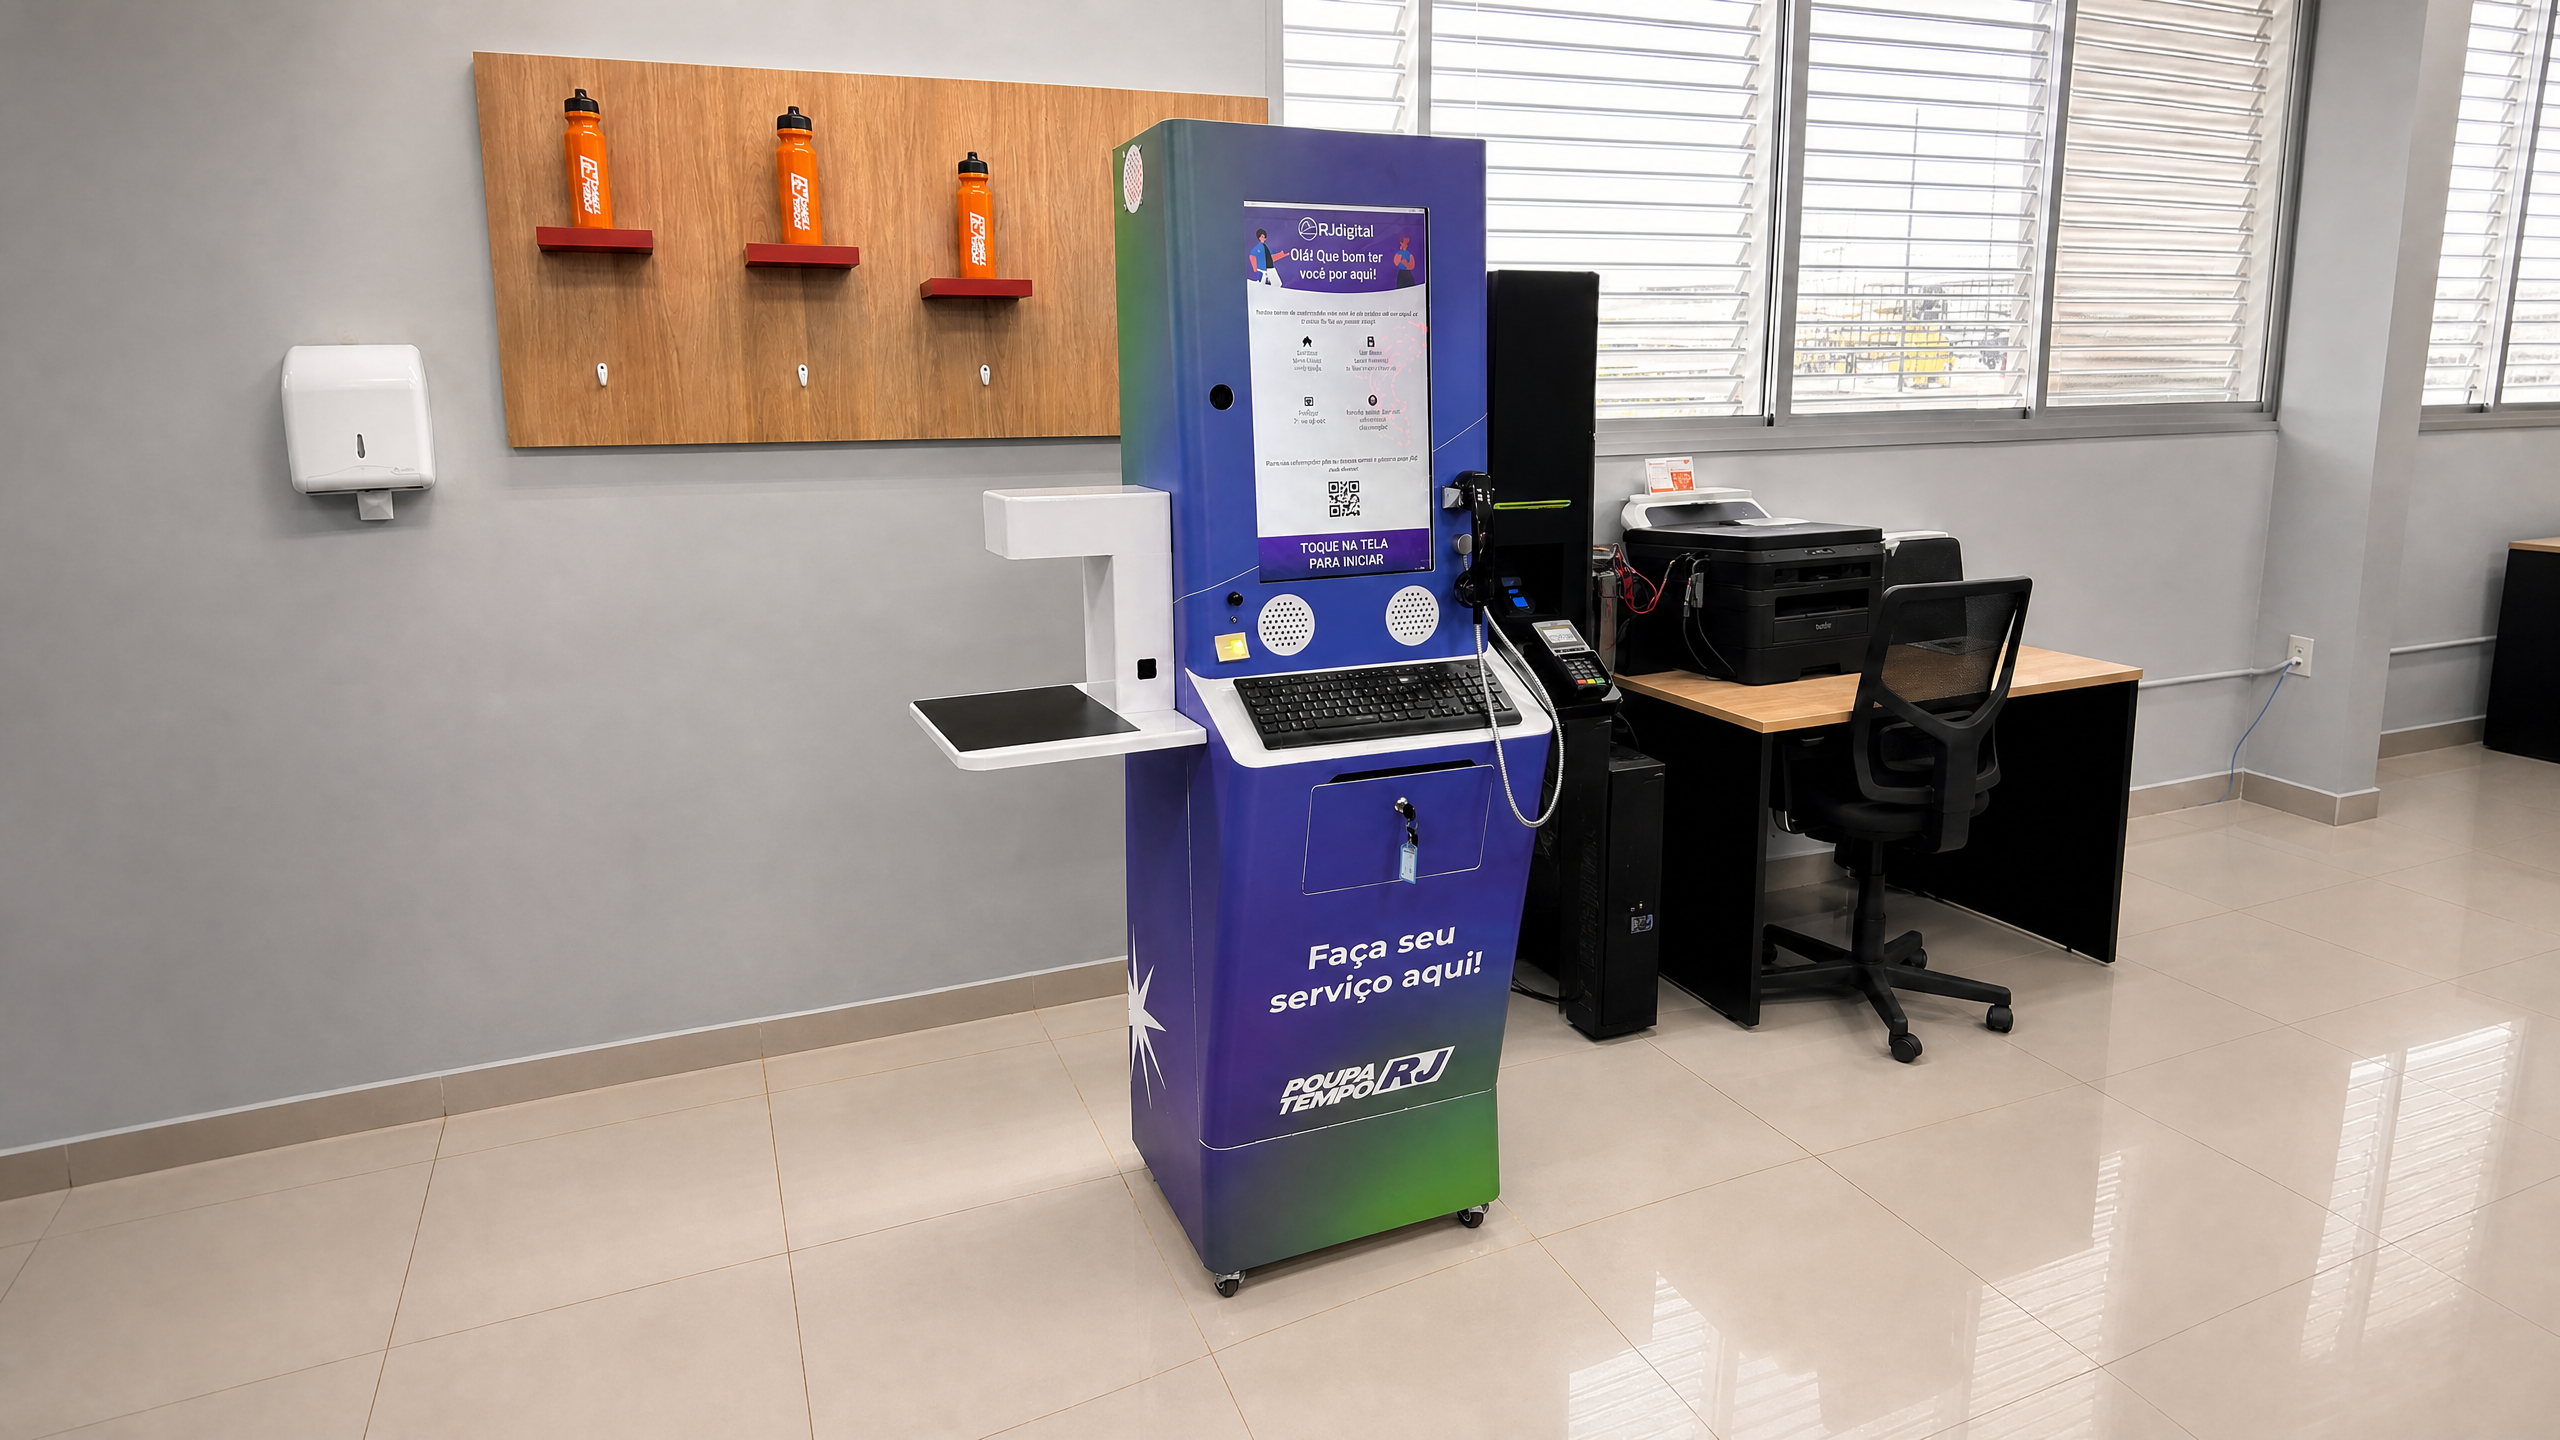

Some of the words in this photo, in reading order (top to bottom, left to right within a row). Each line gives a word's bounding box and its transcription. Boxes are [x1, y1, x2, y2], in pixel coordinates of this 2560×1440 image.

[1318, 222, 1374, 240] RJdigital
[1290, 247, 1314, 262] Olá!
[1316, 249, 1339, 264] Que
[1342, 249, 1366, 262] bom
[1368, 251, 1383, 263] ter
[1329, 269, 1347, 283] por
[1350, 268, 1377, 283] aqui!
[1300, 540, 1340, 555] TOQUE
[1342, 539, 1358, 551] NA
[1360, 537, 1389, 550] TELA
[1309, 556, 1340, 569] PARA
[1343, 553, 1384, 567] INICIAR
[1308, 939, 1387, 970] Faça
[1397, 926, 1456, 954] seu
[1269, 974, 1393, 1014] serviço
[1401, 950, 1483, 987] aqui!
[1281, 1063, 1375, 1098] POUPA
[1377, 1048, 1451, 1092] RJ
[1279, 1080, 1375, 1116] TEMPO
